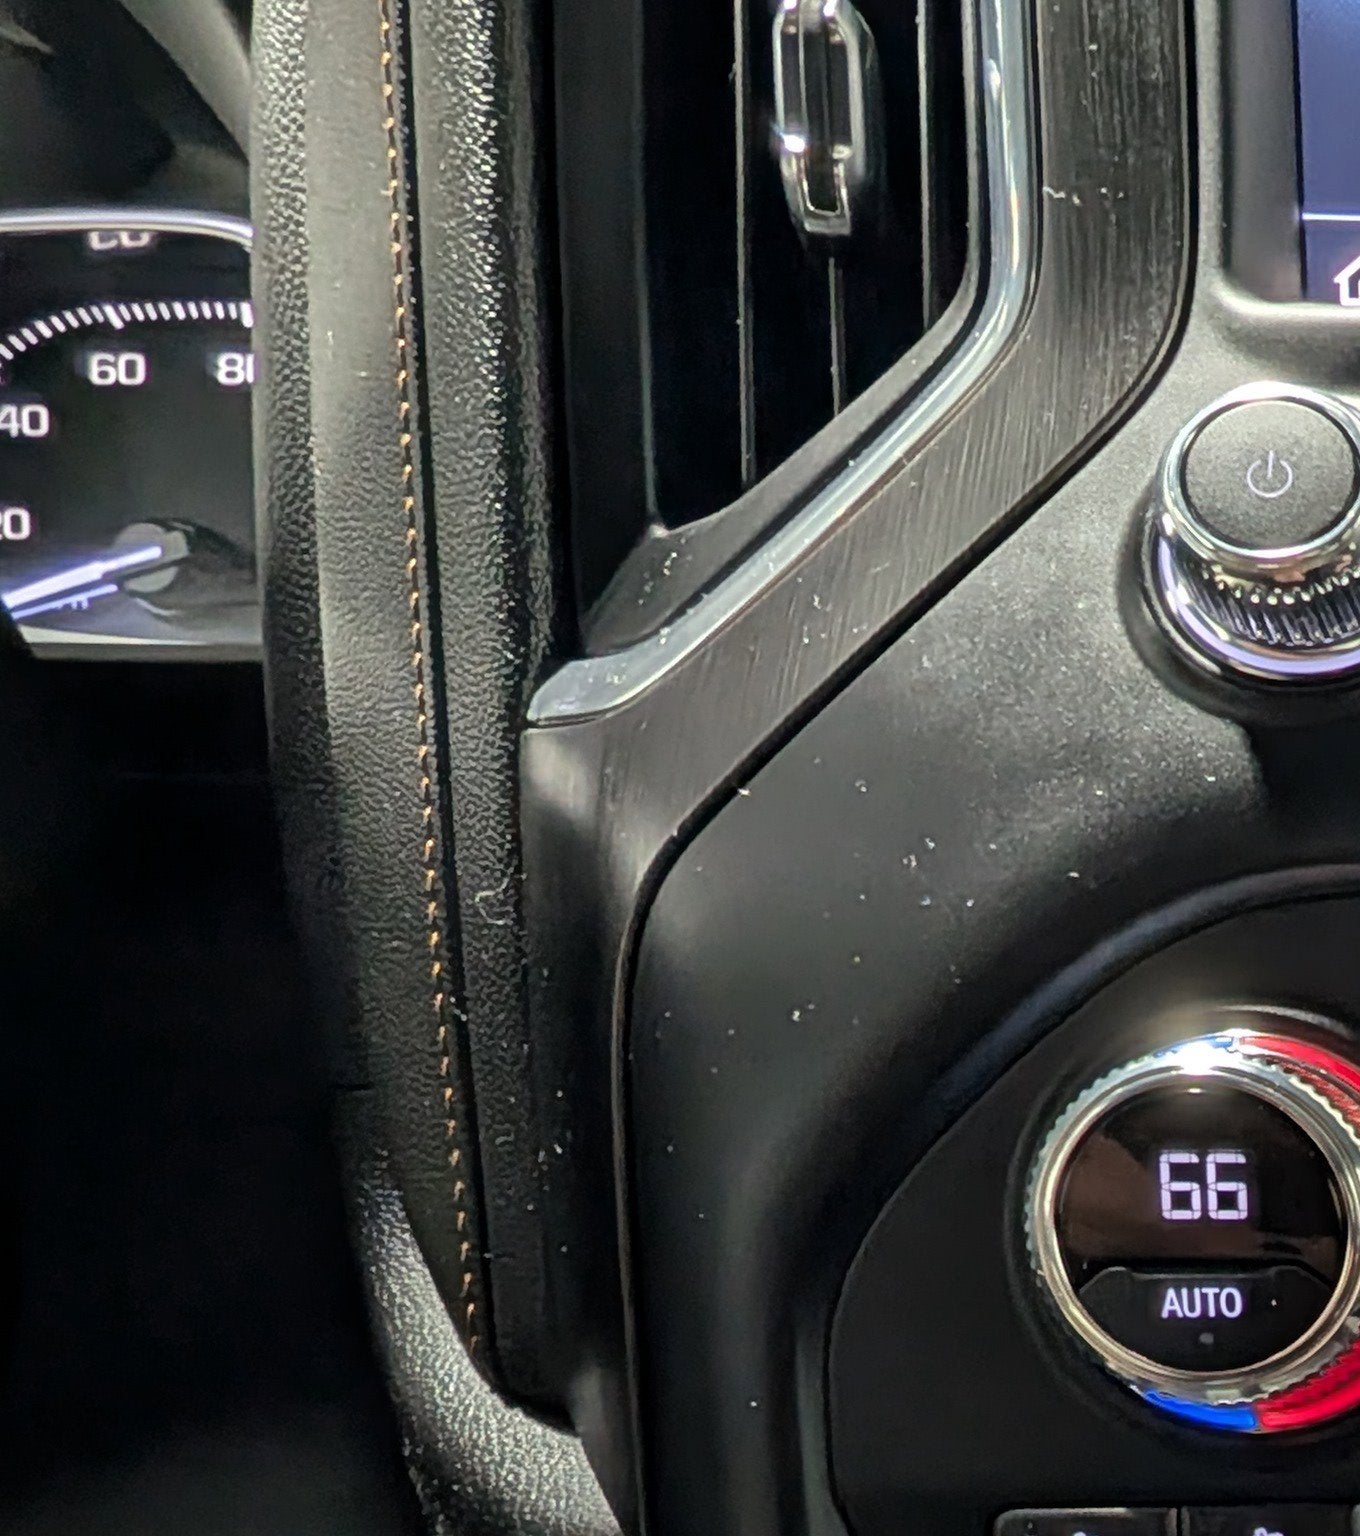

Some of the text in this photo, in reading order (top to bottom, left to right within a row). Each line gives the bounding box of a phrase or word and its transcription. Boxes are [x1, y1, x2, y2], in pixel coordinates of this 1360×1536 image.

[88, 352, 146, 386] 60
[0, 507, 31, 540] 0
[1159, 1152, 1248, 1220] 66
[1161, 1287, 1243, 1318] AUTO
